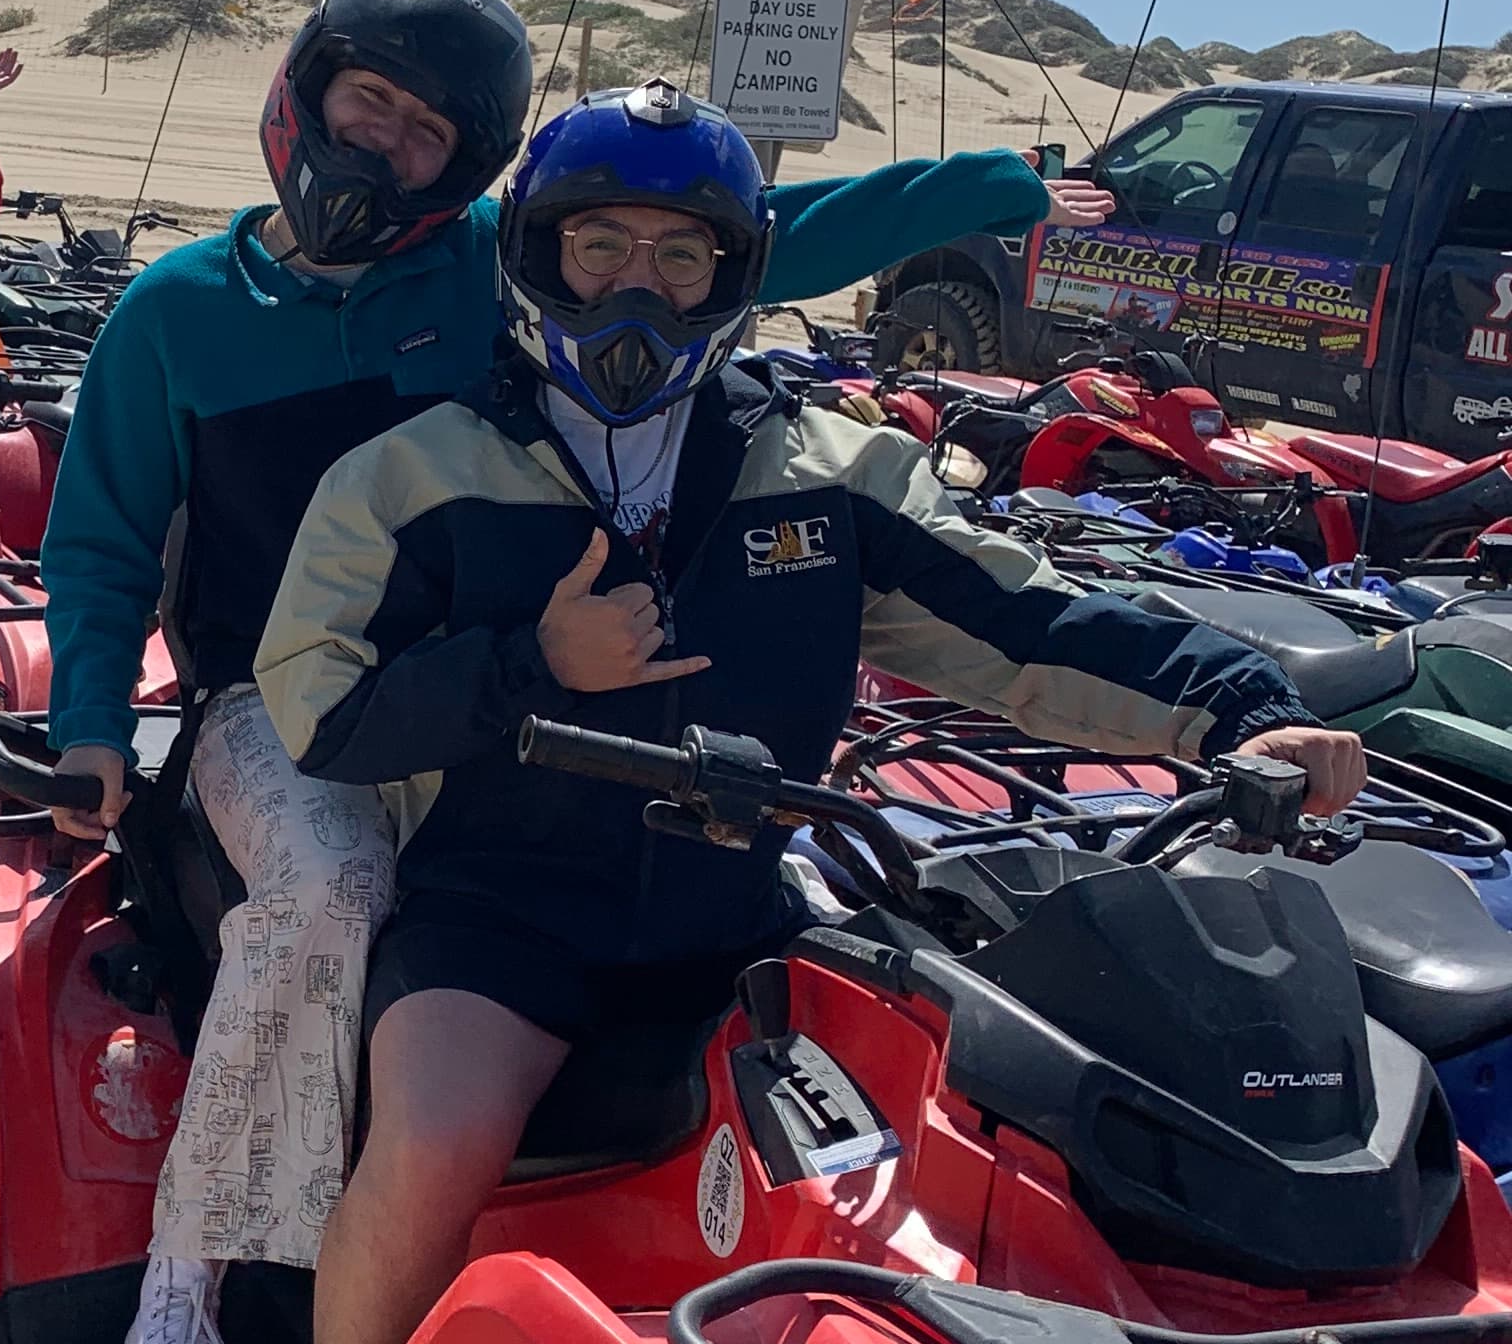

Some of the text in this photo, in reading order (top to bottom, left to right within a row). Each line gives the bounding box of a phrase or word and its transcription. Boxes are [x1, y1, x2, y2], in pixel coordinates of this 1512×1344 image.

[750, 0, 817, 18] DAY USE
[722, 21, 840, 42] PARKING ONLY
[765, 49, 792, 67] NO
[734, 72, 818, 94] CAMPING
[762, 104, 780, 116] Will
[782, 104, 797, 117] Be
[799, 105, 831, 118] Towed
[1043, 235, 1355, 303] SUNBUGIE.co
[1038, 258, 1179, 292] ADVENTURE
[1185, 281, 1288, 307] STARTS
[1295, 296, 1369, 323] NOW!
[1467, 328, 1509, 362] ALL
[743, 515, 831, 566] SF
[747, 555, 838, 577] San Francisco
[1242, 1070, 1344, 1088] OUTLANDER
[720, 1132, 735, 1168] QZ
[704, 1206, 726, 1247] 014
